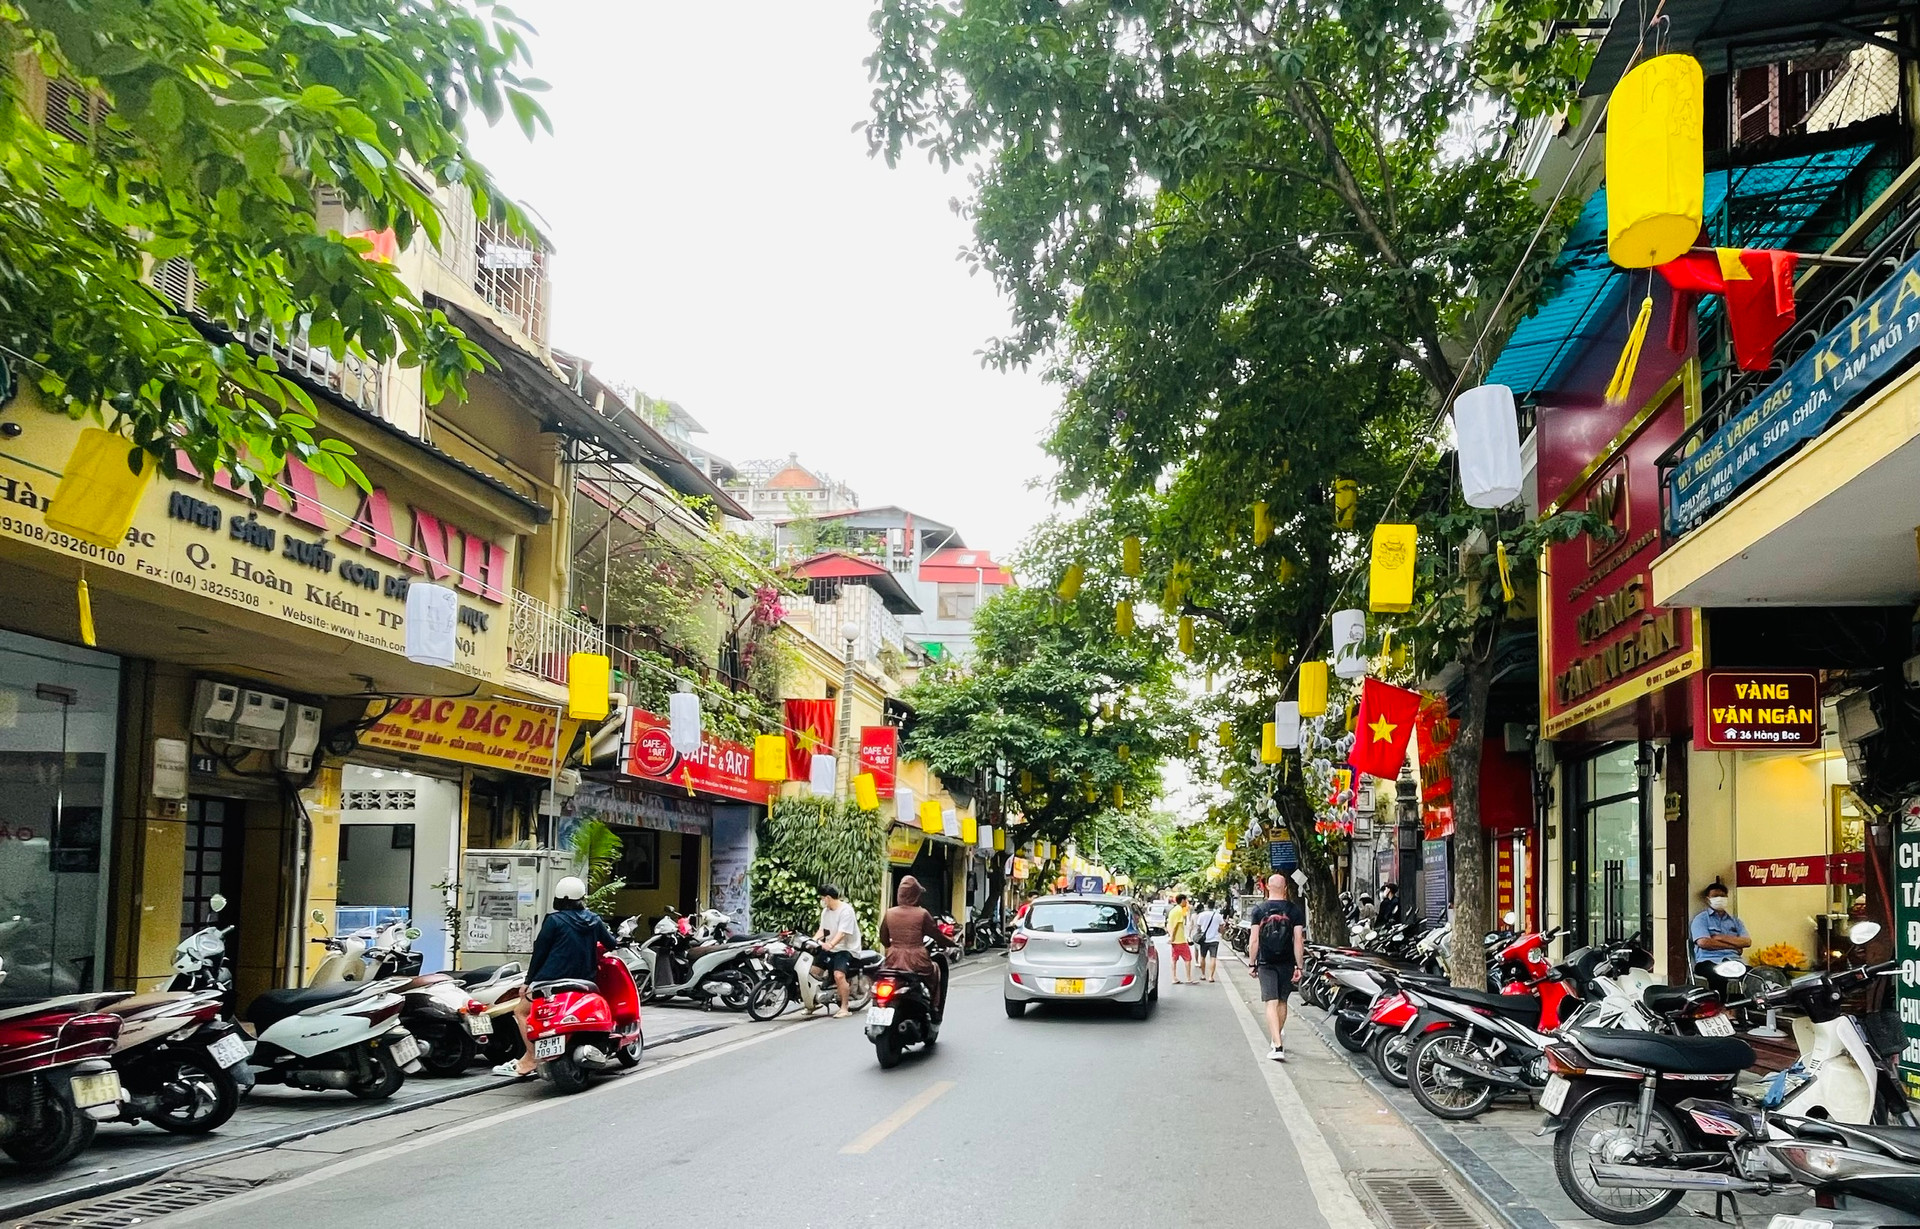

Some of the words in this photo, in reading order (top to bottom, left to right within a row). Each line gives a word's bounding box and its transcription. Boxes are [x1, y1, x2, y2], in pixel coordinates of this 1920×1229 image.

[1710, 462, 1733, 490] MUA
[1736, 442, 1760, 471] BÁN,
[1833, 354, 1867, 392] LÀM
[1869, 323, 1903, 362] MỚI
[1727, 408, 1759, 449] VÀNG
[1762, 380, 1793, 418] BẠC
[125, 525, 156, 549] ạc
[186, 542, 217, 571] Q.
[230, 556, 293, 596] Hoàn
[304, 581, 360, 618] Kiếm
[376, 607, 404, 631] TP
[339, 559, 380, 591] CON
[200, 578, 260, 607] 38255308
[1735, 680, 1790, 700] VÀNG
[457, 704, 512, 737] BÁC
[1712, 704, 1753, 724] VĂN
[1758, 704, 1813, 724] NGÂN
[642, 739, 661, 749] CAFE
[1740, 730, 1752, 740] 36
[1754, 730, 1780, 742] Hàng
[1782, 730, 1801, 742] Bạc
[862, 746, 882, 756] CAFE
[718, 756, 725, 771] &
[725, 750, 750, 777] ART
[1082, 877, 1097, 892] G7
[539, 1037, 560, 1049] 29-H1
